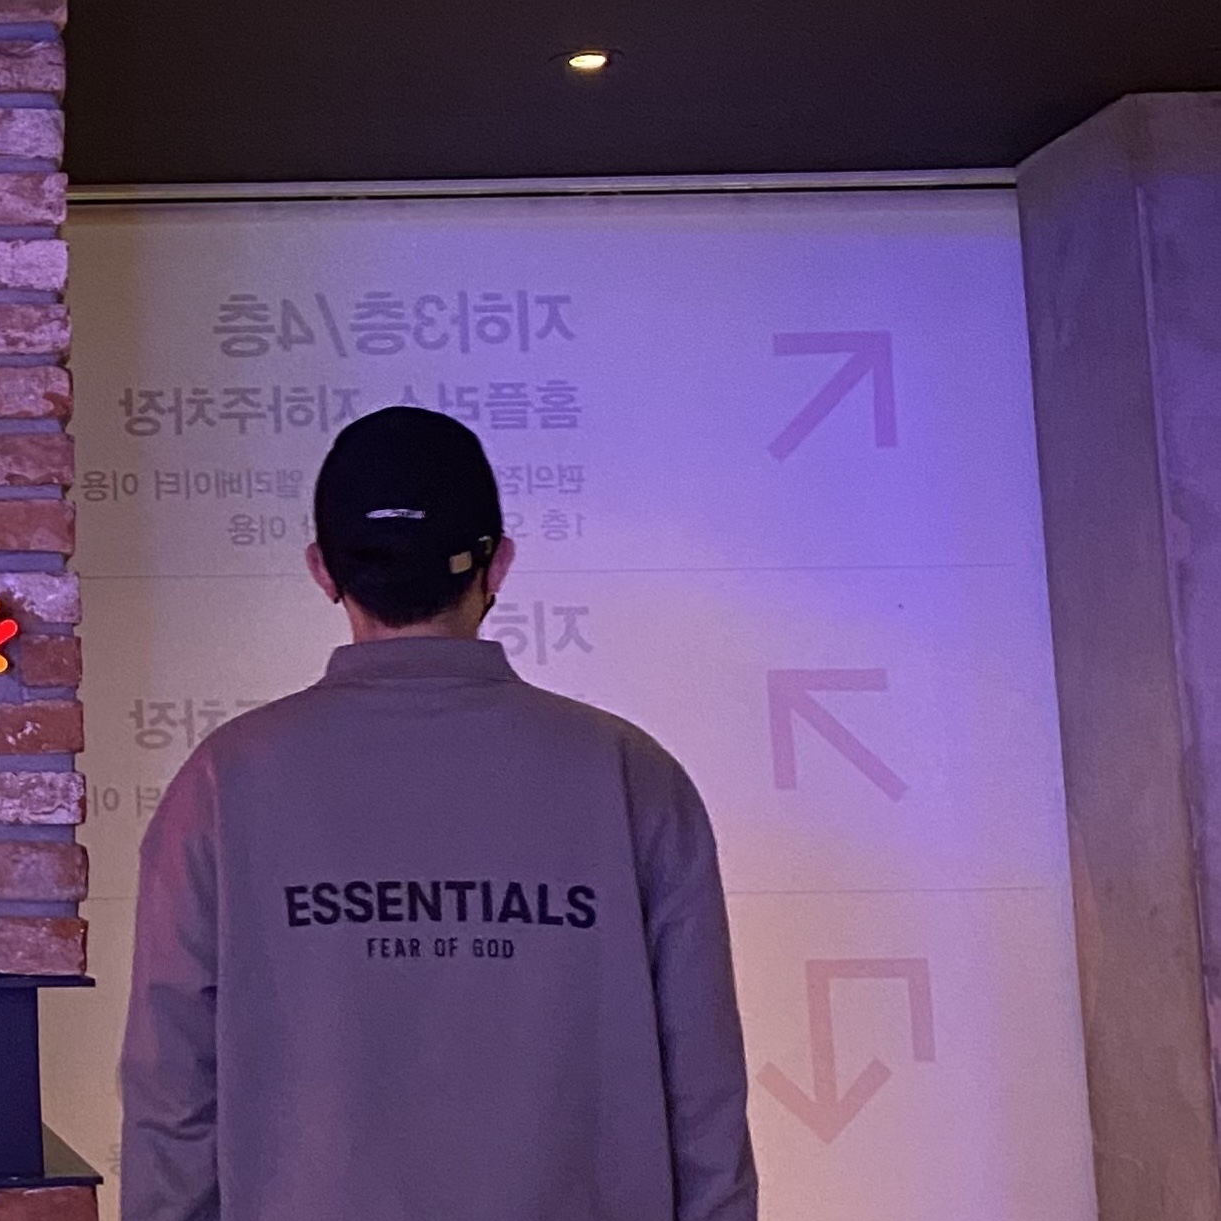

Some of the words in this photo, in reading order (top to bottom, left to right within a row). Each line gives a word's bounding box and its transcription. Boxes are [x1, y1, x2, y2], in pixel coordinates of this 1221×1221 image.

[284, 879, 597, 929] ESSENTIALS
[366, 938, 422, 959] FEAR
[434, 937, 459, 958] OF
[472, 937, 516, 958] GOD
